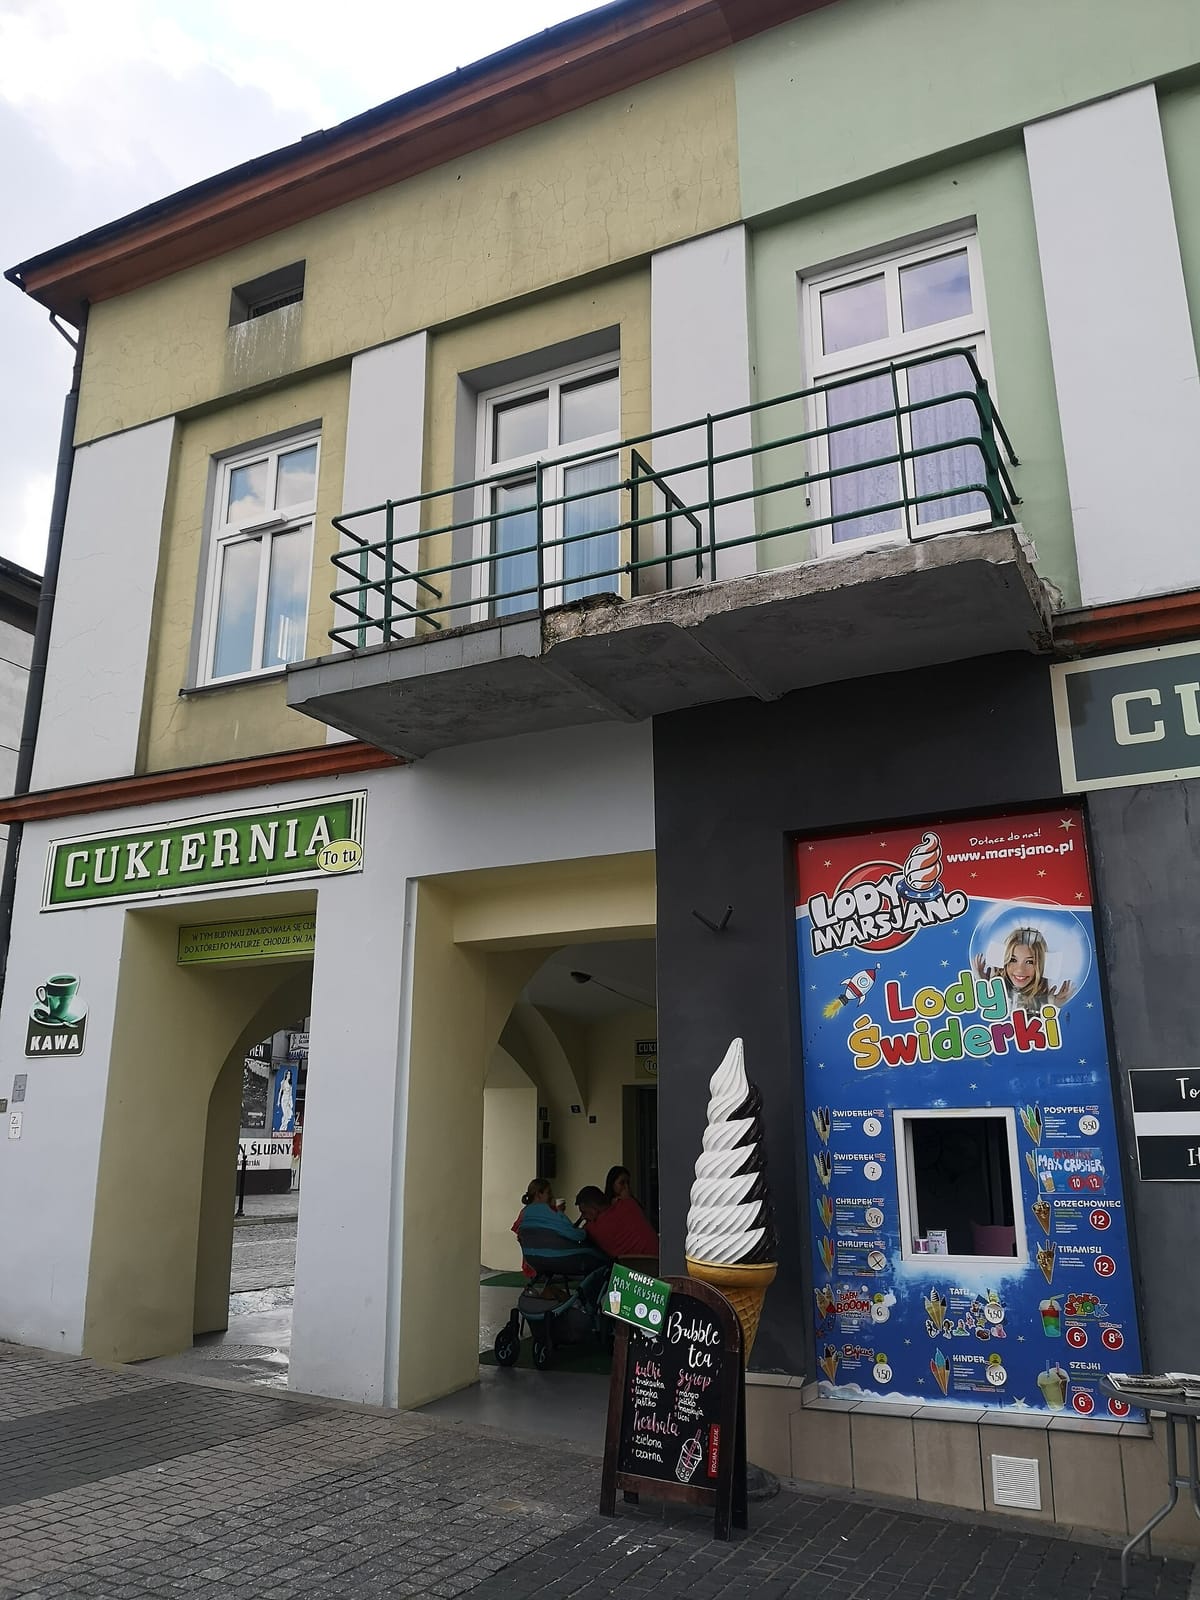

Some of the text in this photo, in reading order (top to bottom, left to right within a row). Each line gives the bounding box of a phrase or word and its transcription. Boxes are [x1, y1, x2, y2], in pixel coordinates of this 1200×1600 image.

[969, 828, 1041, 847] Dołącz do nas!
[65, 815, 333, 888] CUKIERNIA
[322, 847, 358, 867] To tu
[946, 839, 1074, 863] www.marsjano.pl
[810, 873, 900, 928] LODY
[812, 891, 968, 955] MARSJANO
[192, 933, 199, 941] W
[199, 932, 213, 941] TYM
[214, 929, 245, 939] BUDYNKU
[246, 926, 291, 936] ZNAJDOWAŁA
[184, 945, 194, 953] DO
[220, 942, 229, 950] PO
[230, 939, 260, 949] MATURZE
[885, 971, 1009, 1022] Lody
[30, 1034, 79, 1052] KAWA
[848, 1004, 1062, 1070] Świderki
[832, 1109, 873, 1118] ŚWIDEREK
[1044, 1106, 1085, 1114] POSYPEK
[868, 1123, 875, 1132] 5
[250, 1141, 292, 1156] ŚLUBNY
[834, 1151, 874, 1160] ŚWIDEREK
[870, 1166, 877, 1176] 7
[1038, 1154, 1063, 1171] MAX
[1063, 1159, 1103, 1173] CRUSHER
[1072, 1178, 1081, 1188] 10
[1089, 1178, 1100, 1188] 12
[835, 1197, 873, 1206] CHRUPEK
[1054, 1199, 1121, 1208] ORZECHOWIEC
[1093, 1214, 1105, 1226] 12
[837, 1240, 874, 1249] CHRUPEK
[1058, 1245, 1102, 1254] TIRAMISU
[1097, 1261, 1109, 1272] 12
[613, 1275, 665, 1306] MAX CRUSHER
[1064, 1302, 1109, 1318] SZOK
[667, 1311, 720, 1346] Bubble
[688, 1344, 713, 1368] tea
[952, 1354, 985, 1364] KINDER
[634, 1360, 662, 1380] kulki
[1069, 1361, 1101, 1370] SZEJKI
[677, 1368, 713, 1392] syrop
[635, 1386, 659, 1399] limonka
[679, 1390, 700, 1400] mango
[633, 1410, 680, 1437] herbata
[635, 1434, 663, 1449] zielona
[635, 1449, 664, 1463] czarna
